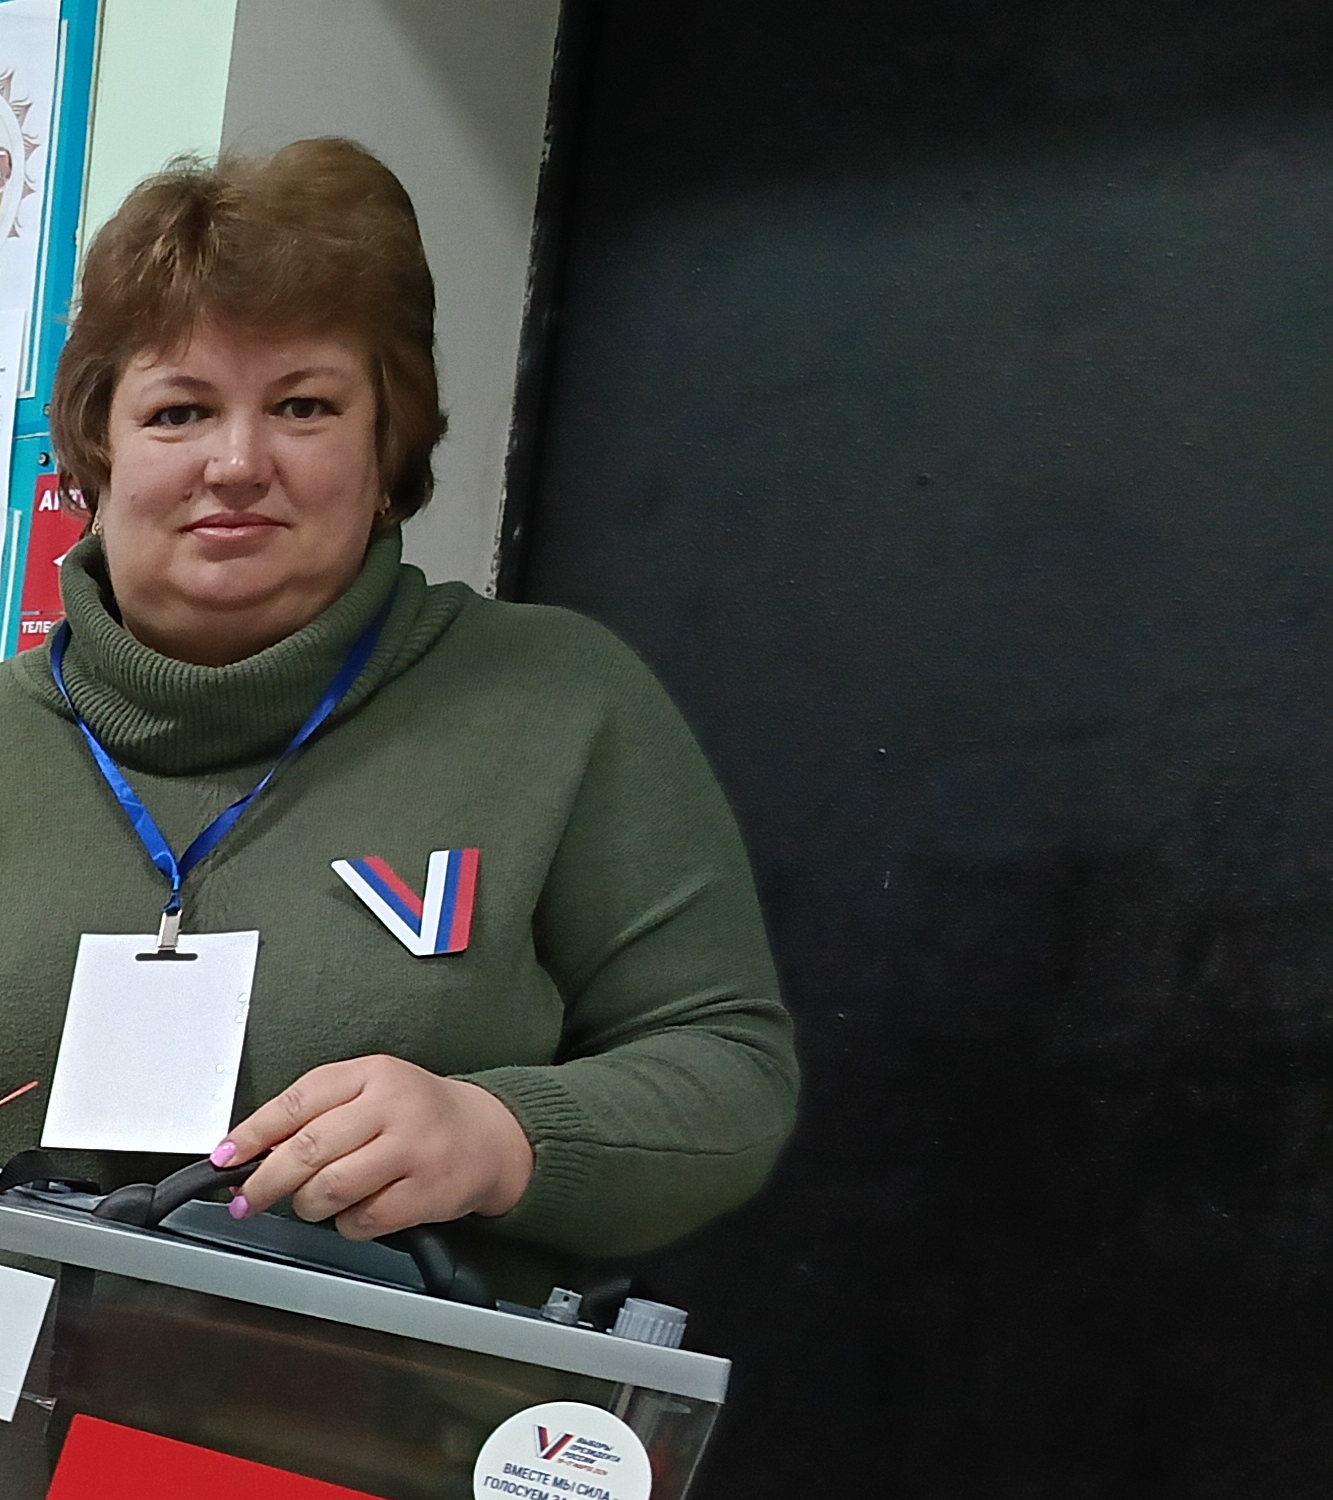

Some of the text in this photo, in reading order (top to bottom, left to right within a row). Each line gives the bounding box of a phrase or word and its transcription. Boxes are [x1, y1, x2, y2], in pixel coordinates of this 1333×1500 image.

[21, 621, 54, 634] ТЕЛЕ
[503, 1463, 551, 1485] ВМЕСТЕ
[552, 1477, 576, 1491] МЫ
